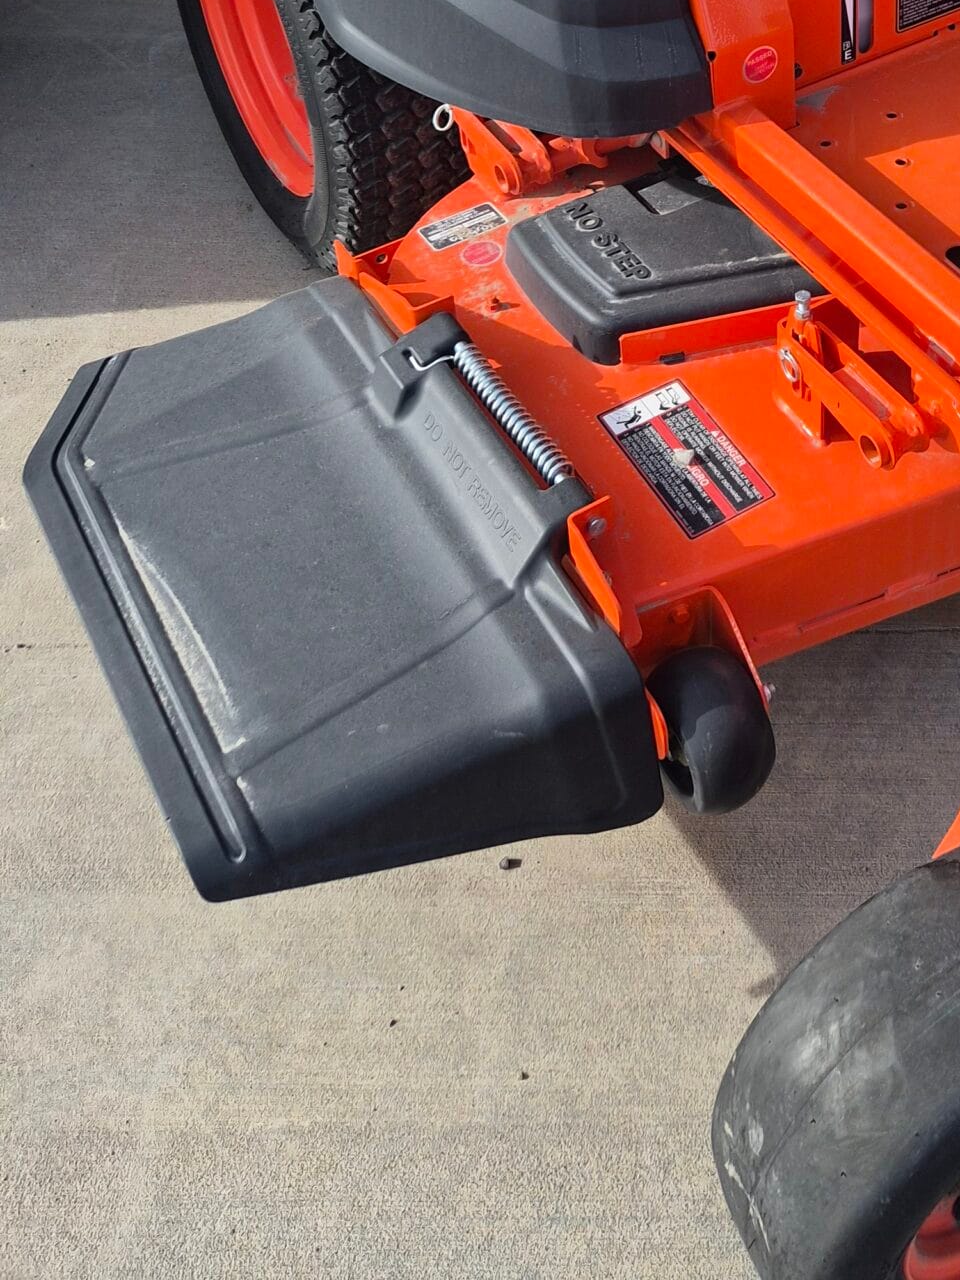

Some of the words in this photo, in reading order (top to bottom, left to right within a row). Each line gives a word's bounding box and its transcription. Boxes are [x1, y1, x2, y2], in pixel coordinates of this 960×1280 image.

[844, 49, 853, 60] E
[562, 202, 604, 232] NO
[591, 232, 653, 280] STEP
[715, 435, 746, 466] DANGER
[422, 413, 443, 442] DO
[441, 440, 473, 480] NOT
[466, 476, 522, 553] REMOVE
